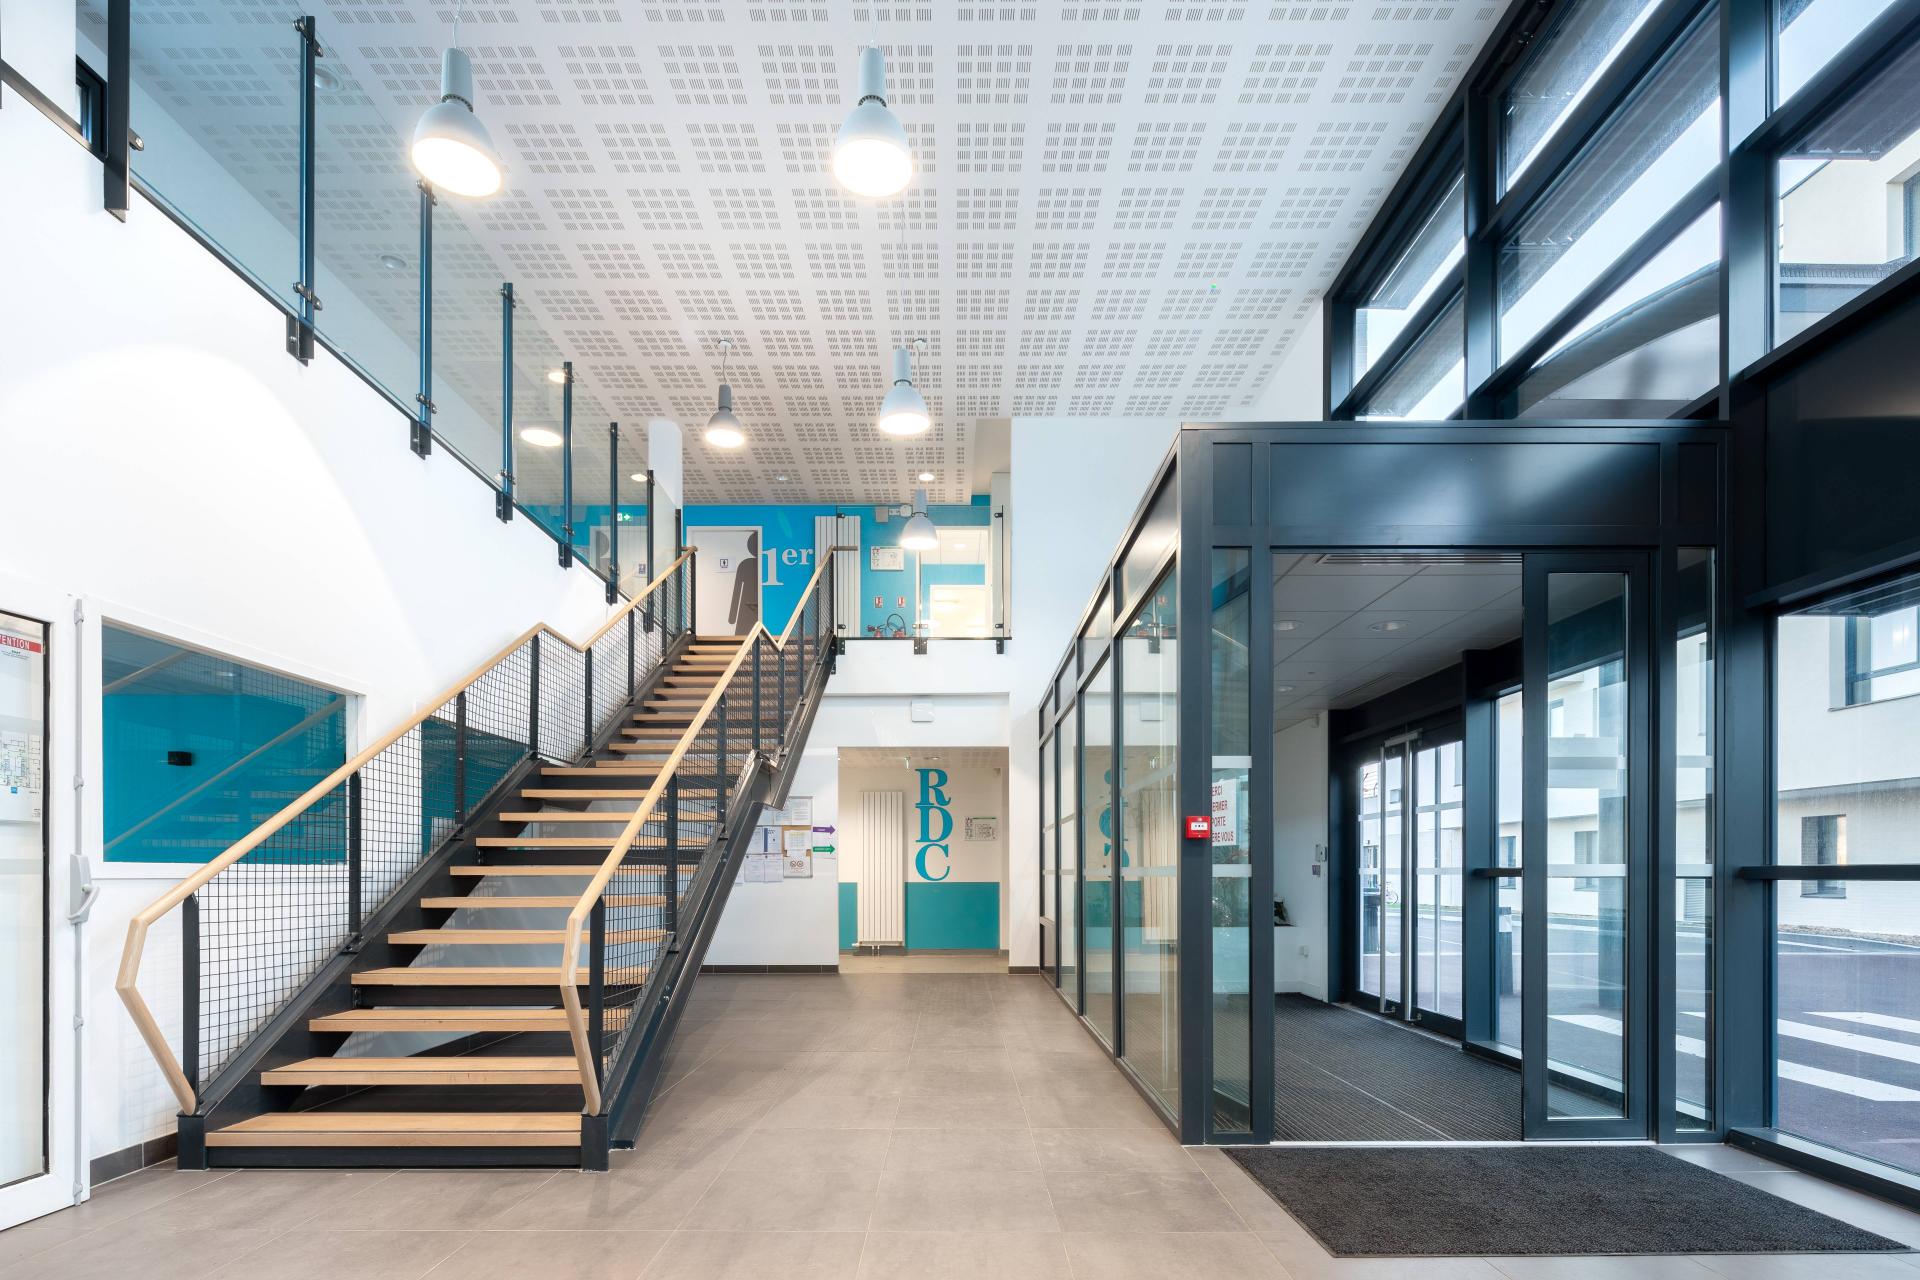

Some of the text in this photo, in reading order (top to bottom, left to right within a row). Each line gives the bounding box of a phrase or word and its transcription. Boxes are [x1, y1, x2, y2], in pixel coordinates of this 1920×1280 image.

[761, 548, 814, 587] 1er
[1211, 784, 1223, 797] ERCI
[1211, 799, 1228, 812] ERMER
[914, 768, 953, 882] RDC
